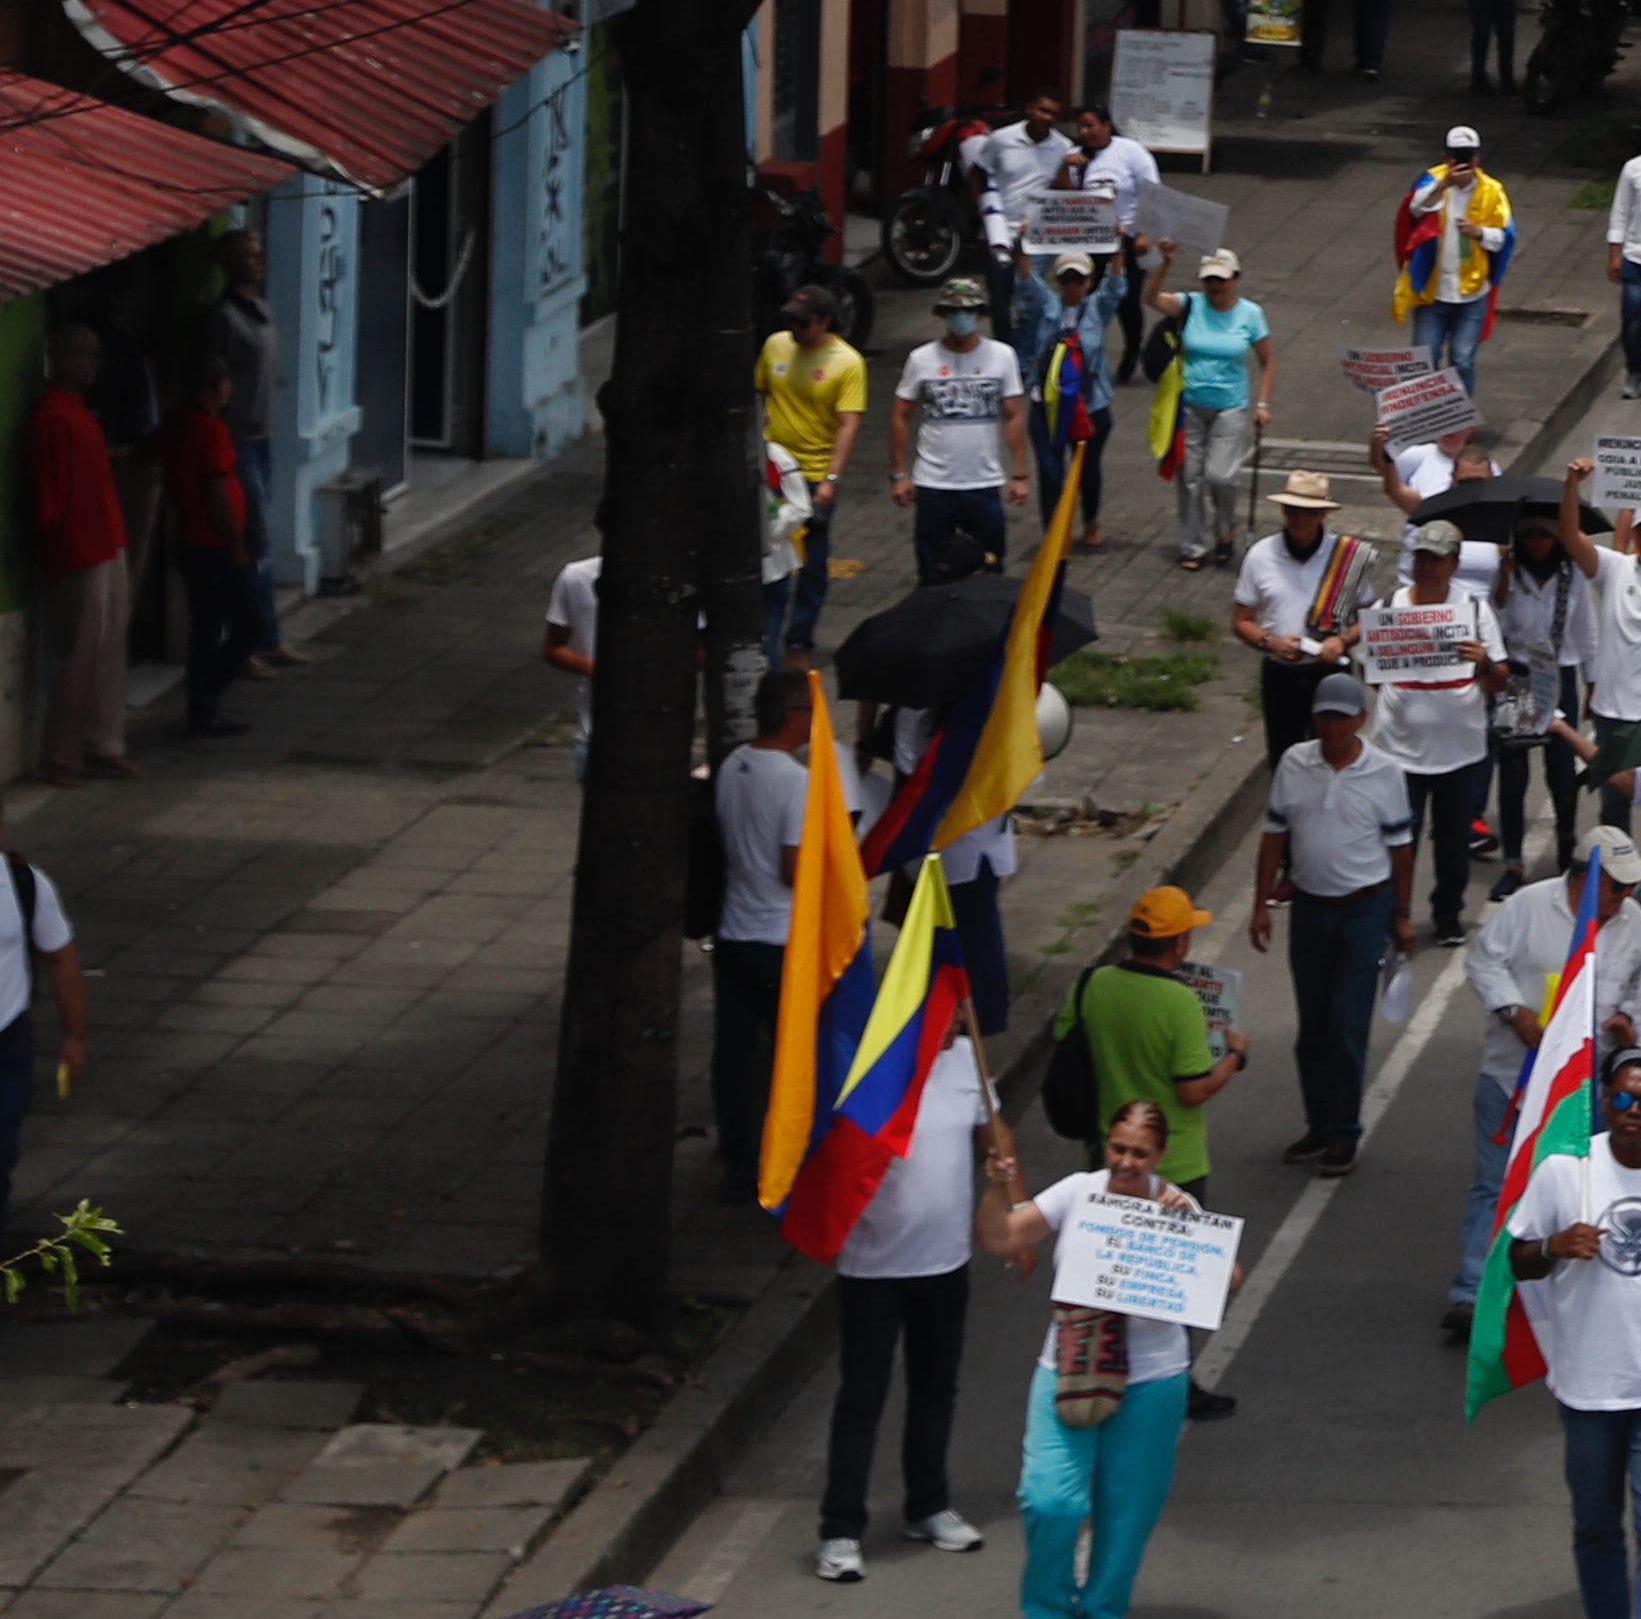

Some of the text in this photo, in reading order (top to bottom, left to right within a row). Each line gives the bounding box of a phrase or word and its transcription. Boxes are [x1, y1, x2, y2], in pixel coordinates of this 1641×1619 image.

[1378, 608, 1455, 627] UN GOBIERNO
[1432, 624, 1470, 639] INCITA
[1138, 1231, 1157, 1243] DE
[1095, 1248, 1113, 1260] LA
[1105, 1236, 1197, 1261] EL BANCO DE
[1111, 1263, 1131, 1276] SU
[1095, 1272, 1116, 1286] SU
[1094, 1285, 1185, 1314] SU LIBERTAD
